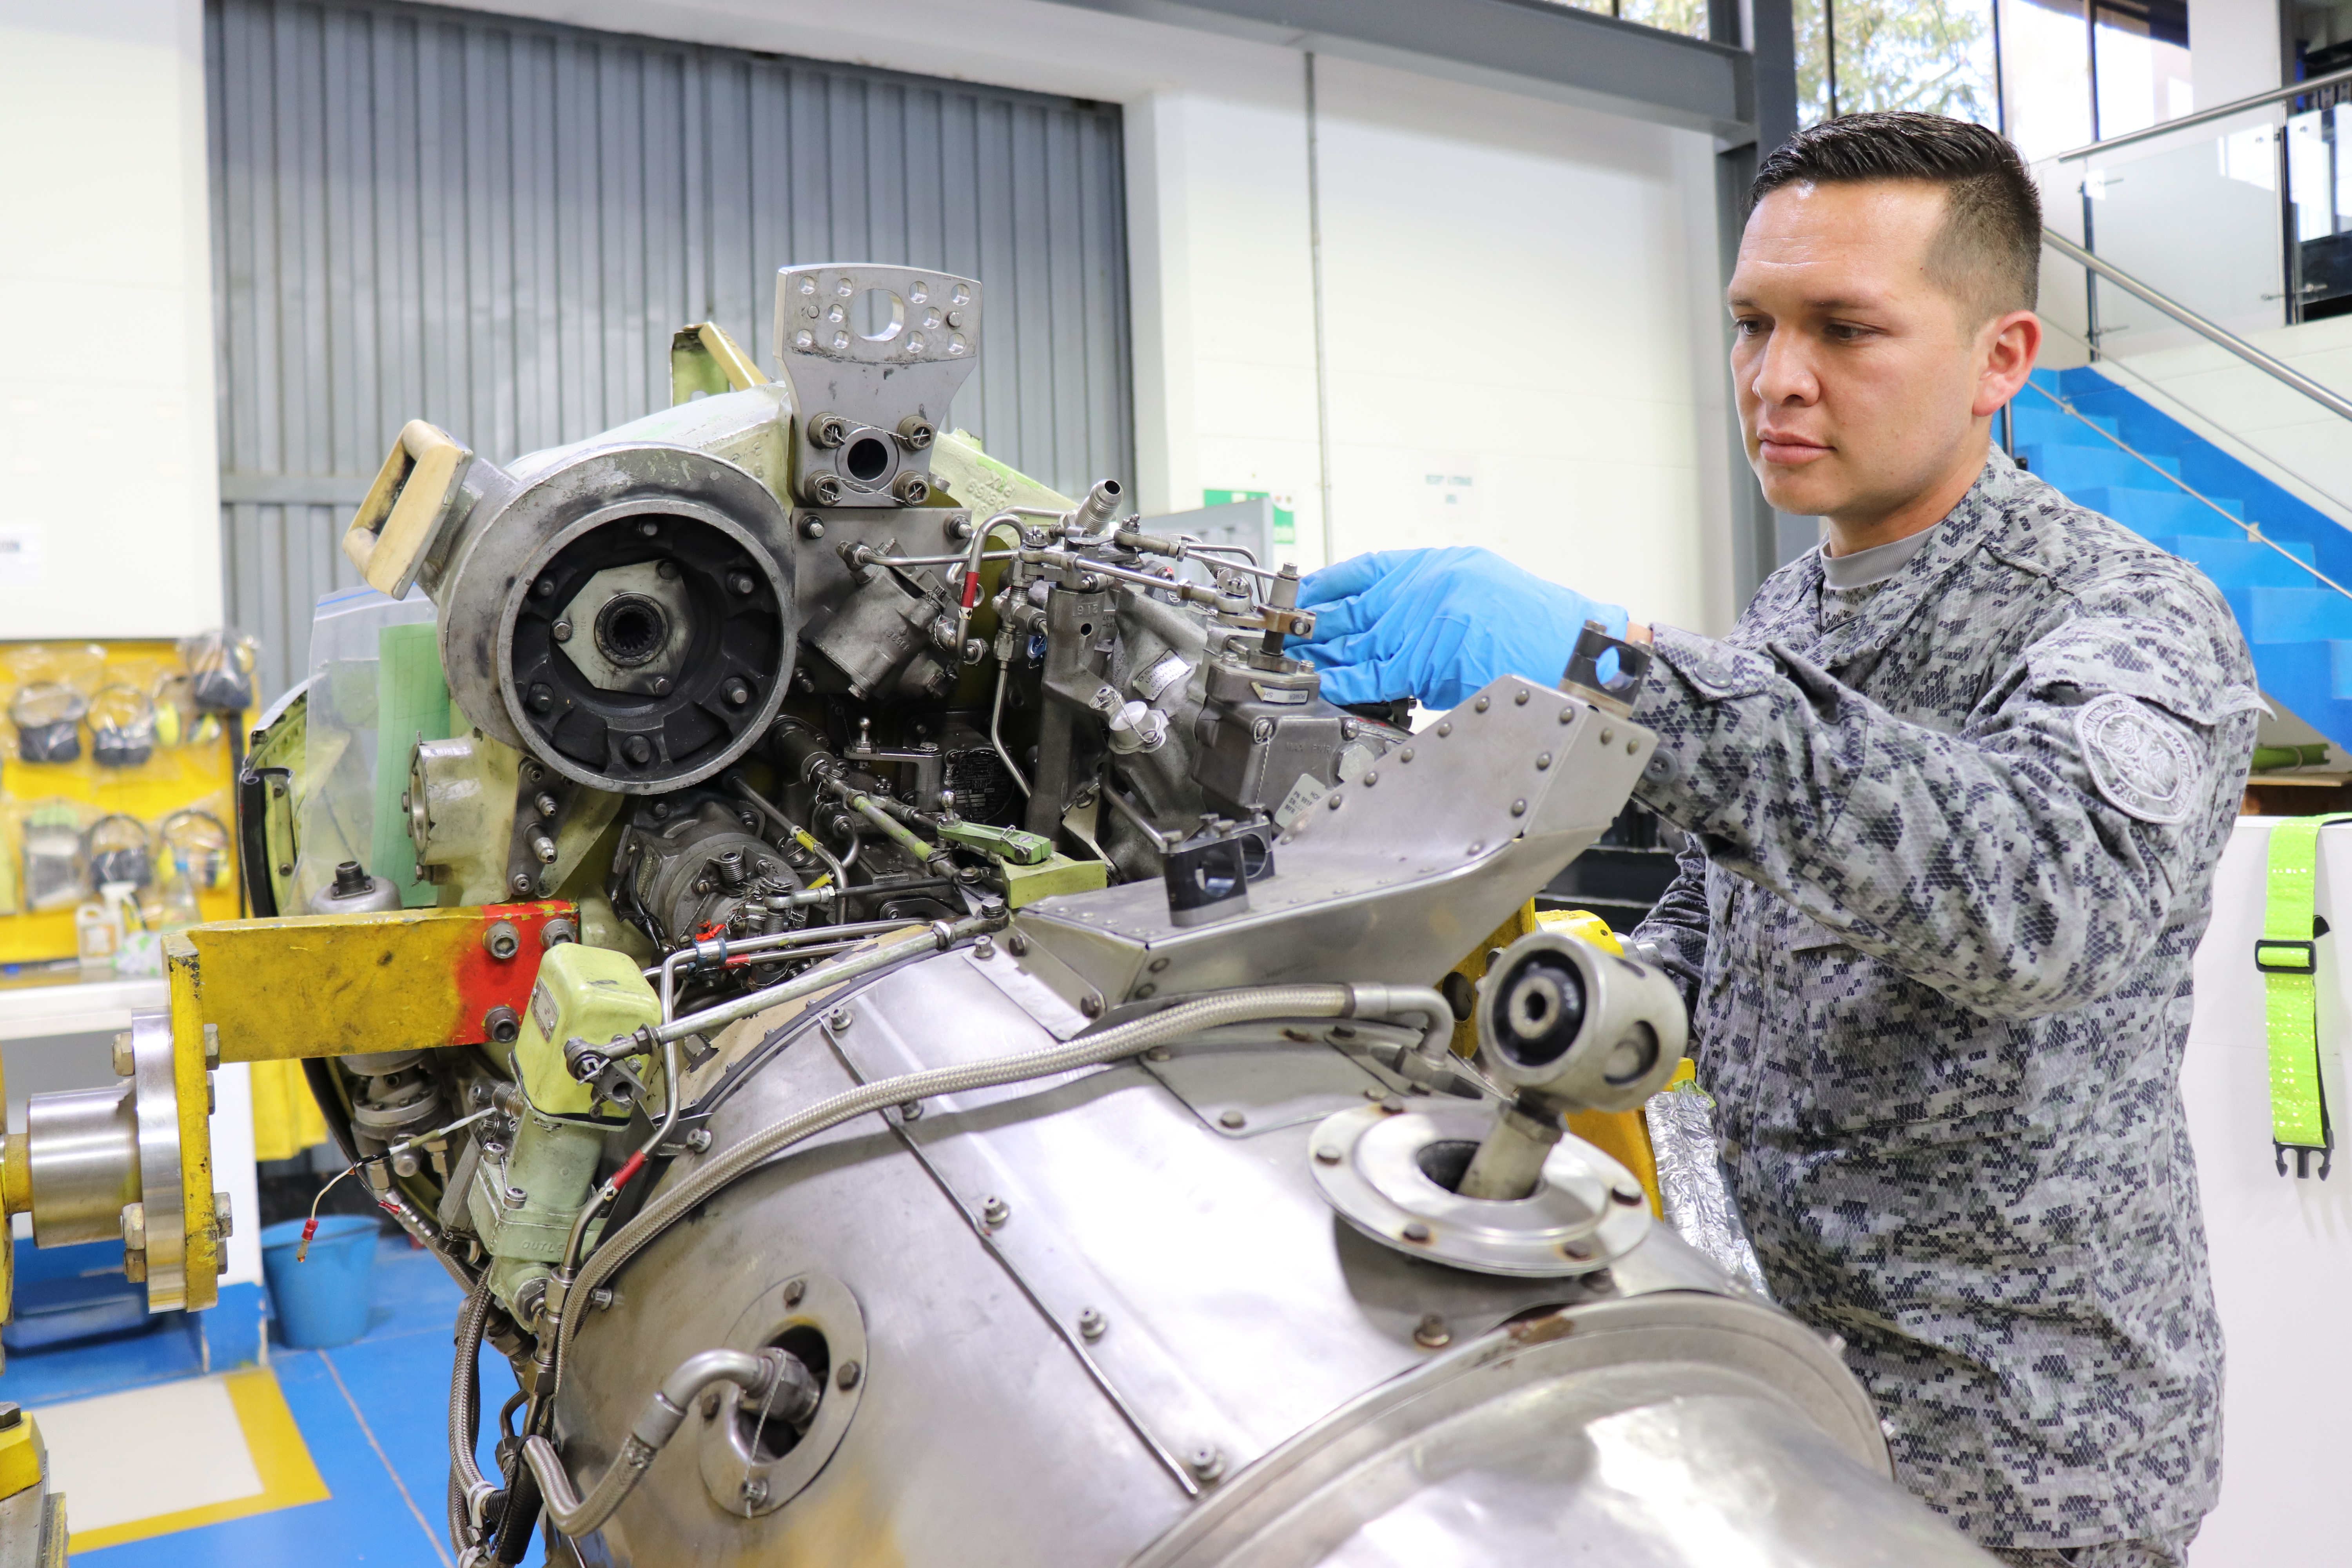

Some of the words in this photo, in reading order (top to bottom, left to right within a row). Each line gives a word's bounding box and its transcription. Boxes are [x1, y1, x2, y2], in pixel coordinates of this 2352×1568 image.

[1145, 663, 1171, 684] UNDER
[1151, 667, 1175, 688] COVER
[1151, 684, 1163, 696] CW
[1293, 791, 1301, 799] PN
[2111, 782, 2138, 805] FAC
[1284, 804, 1296, 815] MFR
[522, 1241, 564, 1253] OUTLE
